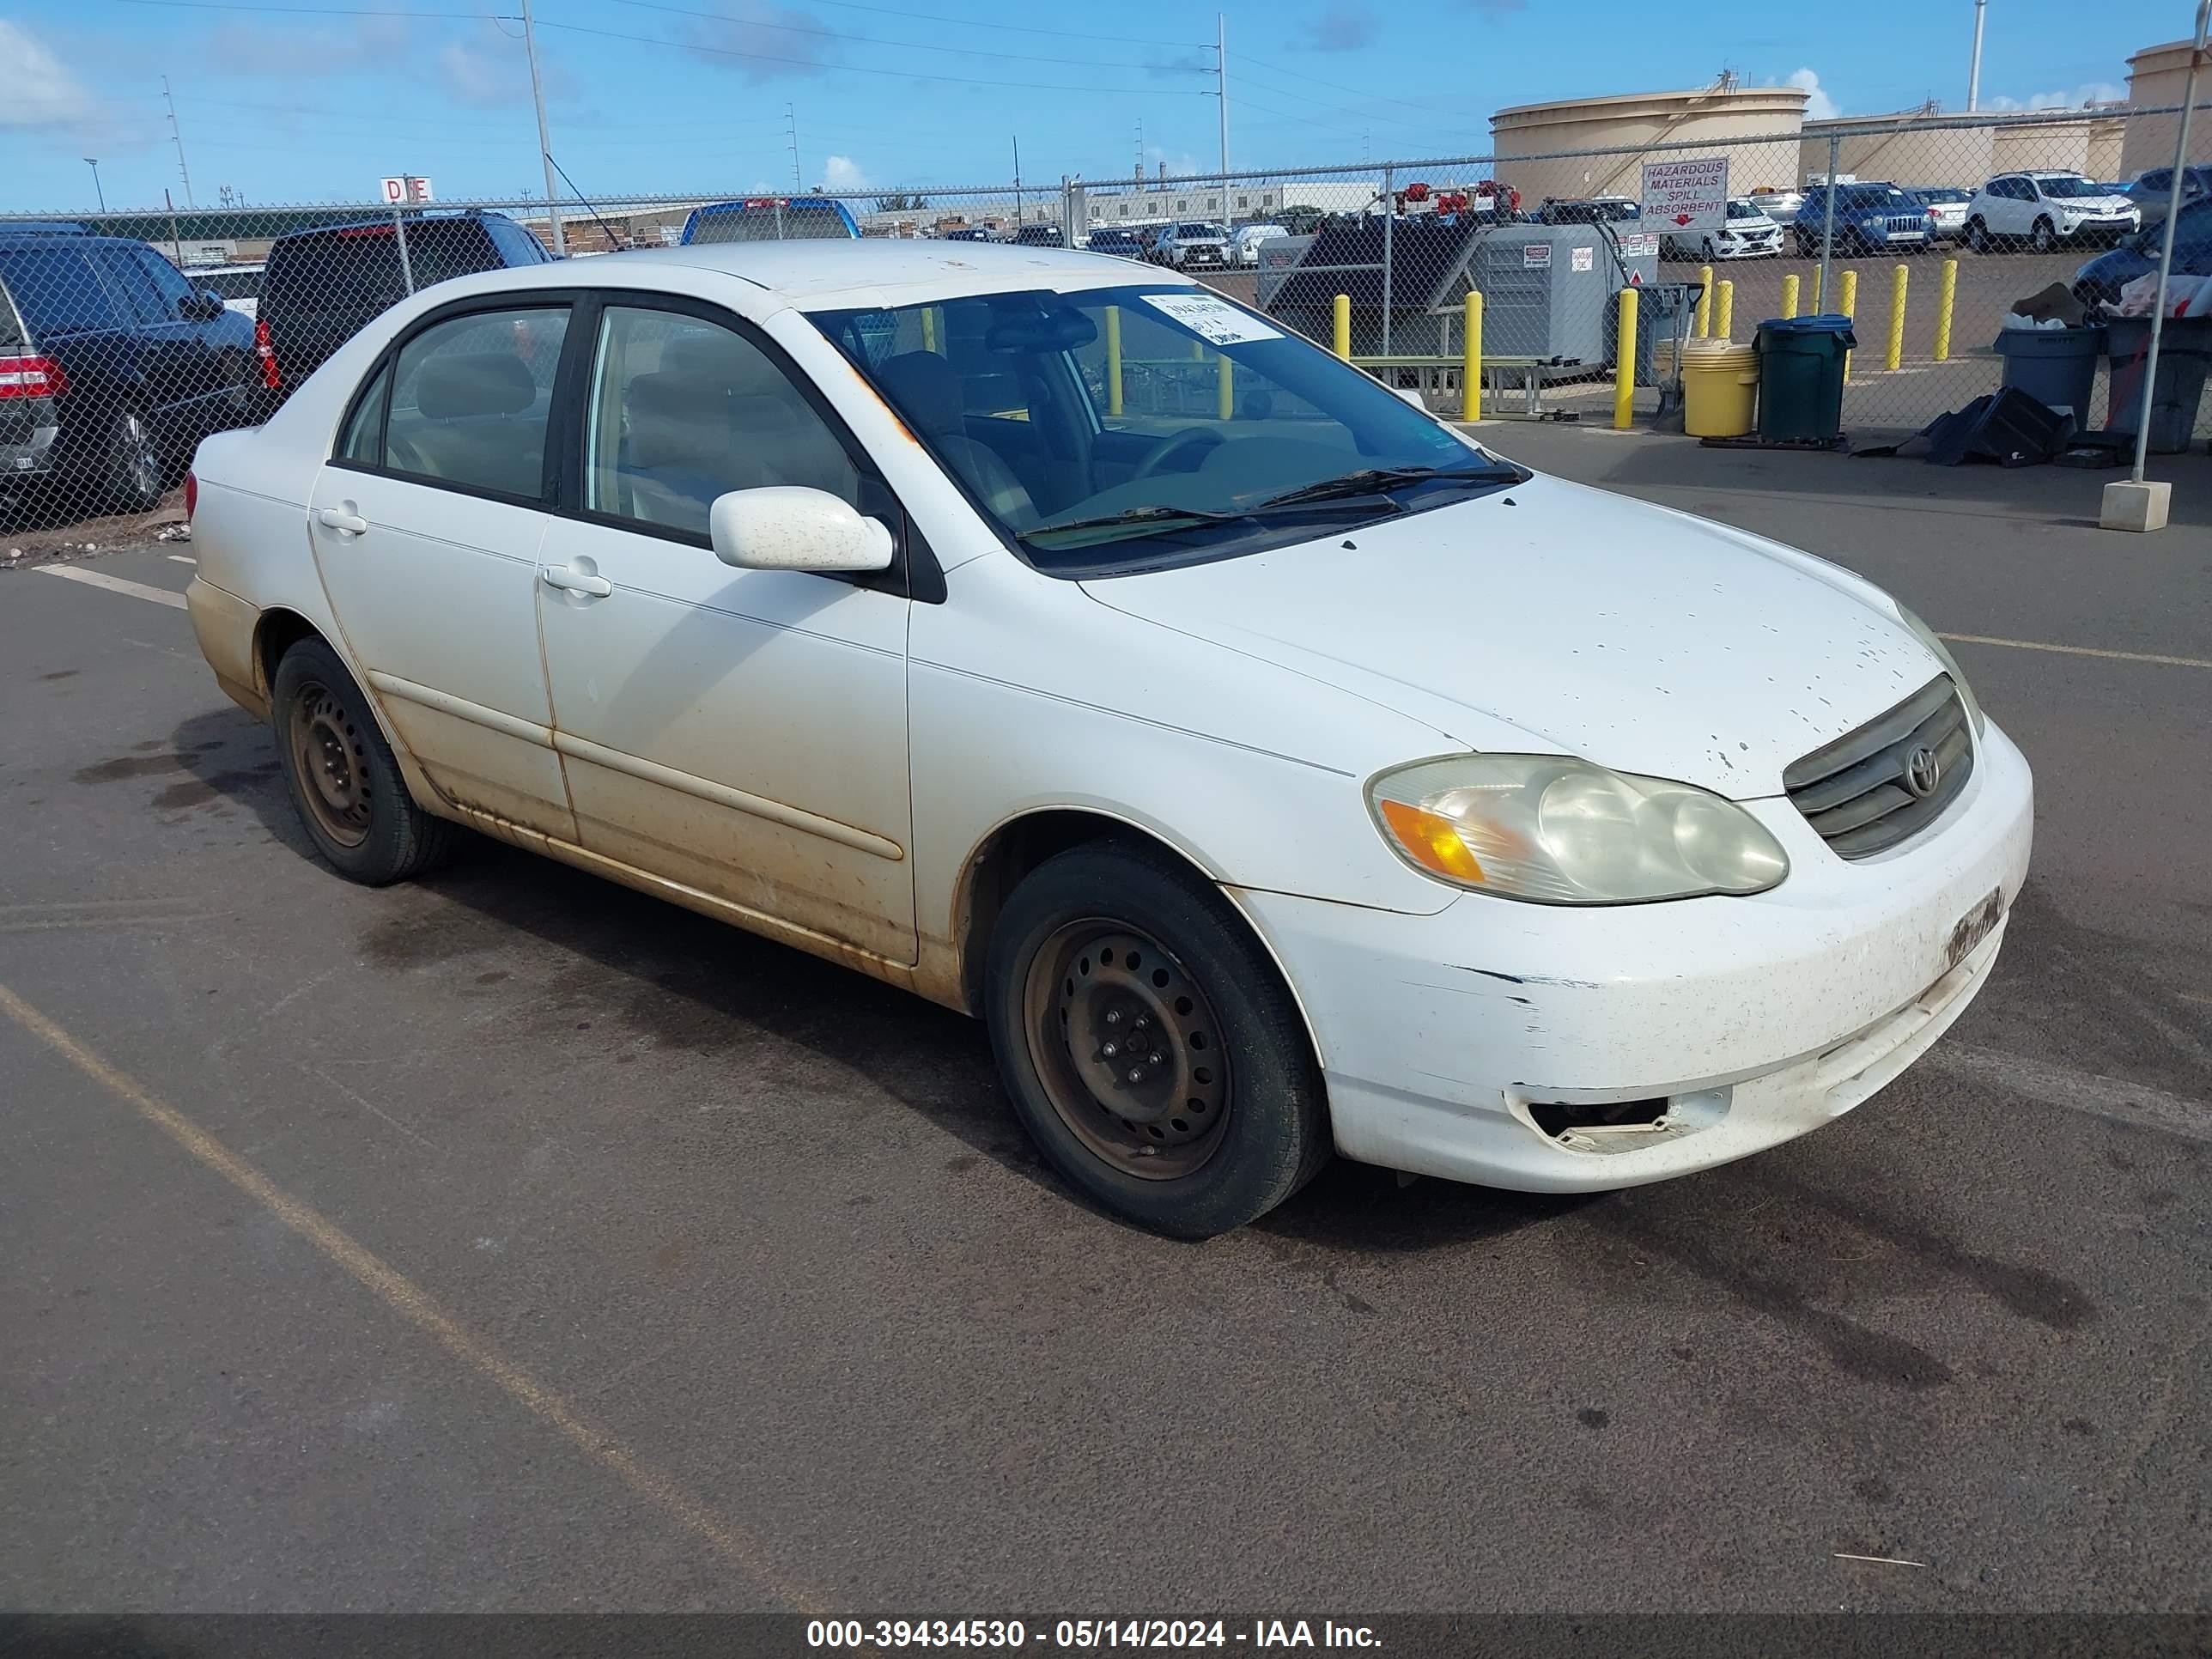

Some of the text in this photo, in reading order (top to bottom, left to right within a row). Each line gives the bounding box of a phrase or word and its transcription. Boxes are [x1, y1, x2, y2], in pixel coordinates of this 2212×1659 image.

[1647, 162, 1723, 178] HAZARDOUS
[387, 180, 400, 199] D
[1650, 176, 1718, 190] MATERIALS
[1667, 190, 1700, 202] SPILL
[1645, 201, 1722, 215] ABSORBENT
